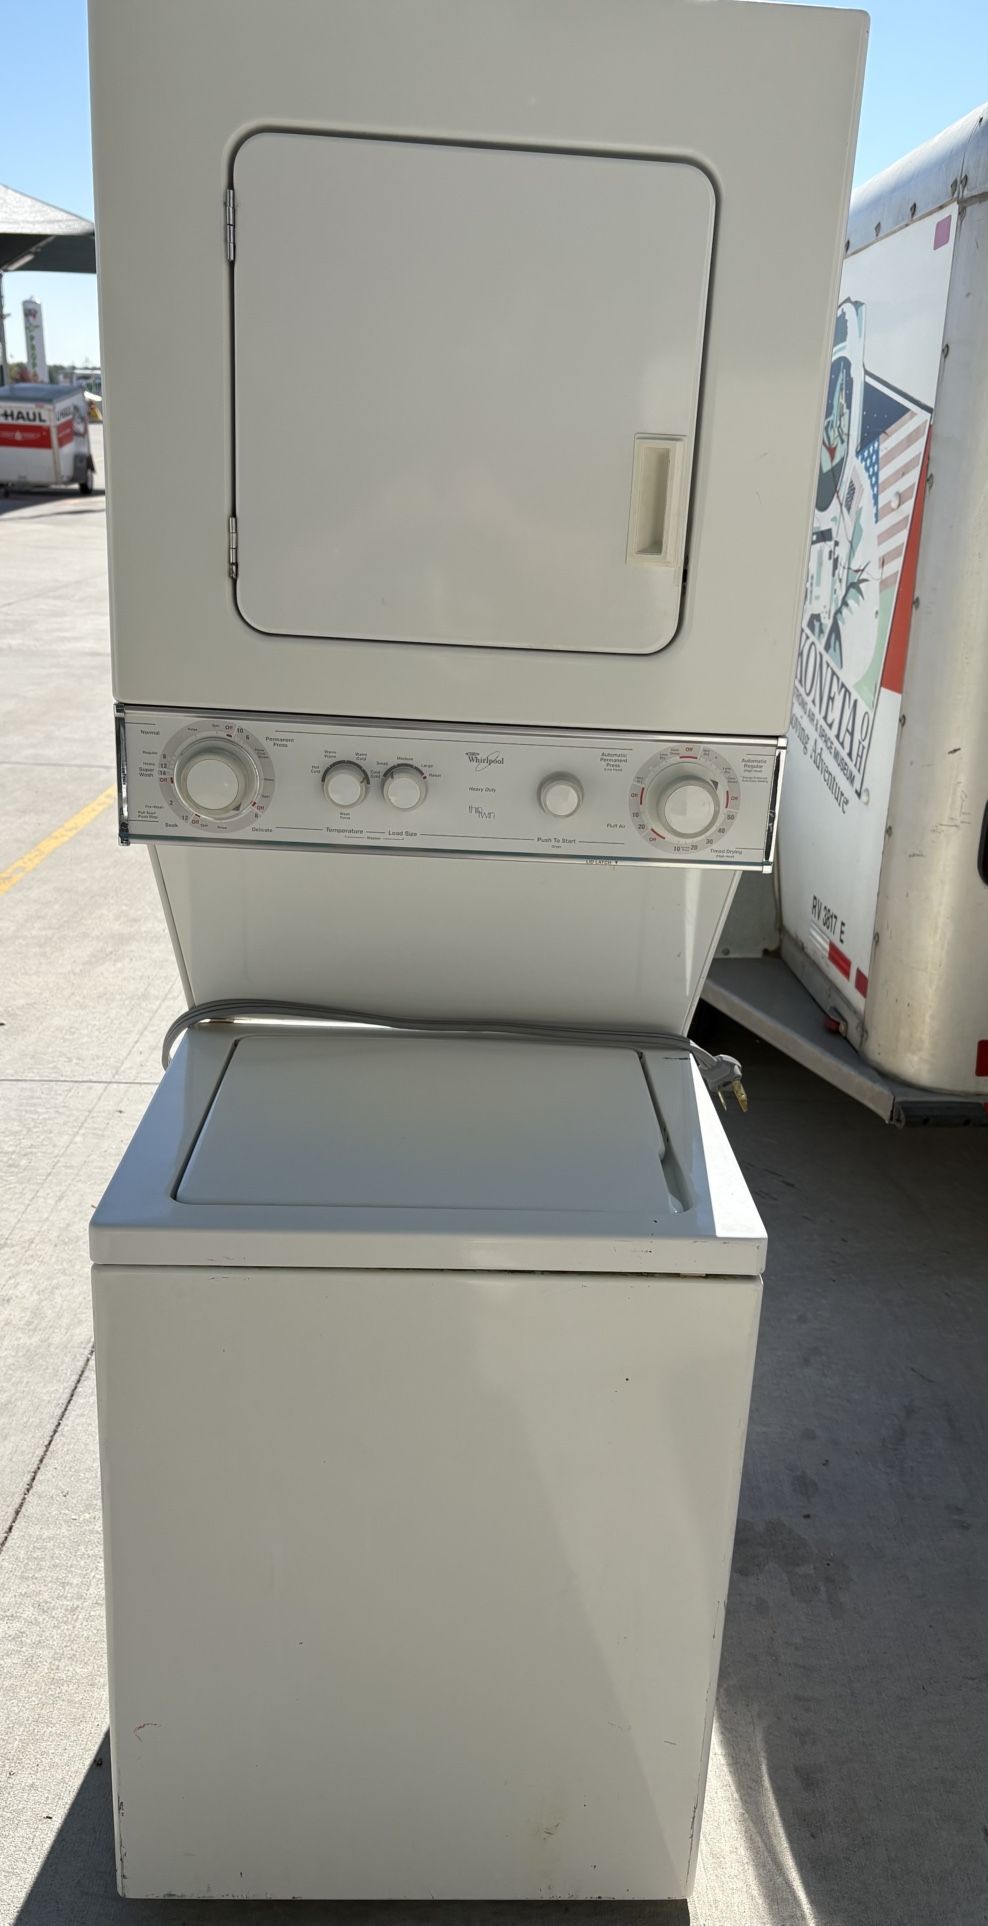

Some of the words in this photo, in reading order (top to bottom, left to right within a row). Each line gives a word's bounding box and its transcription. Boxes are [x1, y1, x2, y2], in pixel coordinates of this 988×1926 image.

[468, 755, 505, 766] Whirlpool
[326, 826, 364, 835] Temperature
[388, 828, 404, 837] Load
[822, 905, 838, 936] 3817
[839, 920, 846, 945] E
